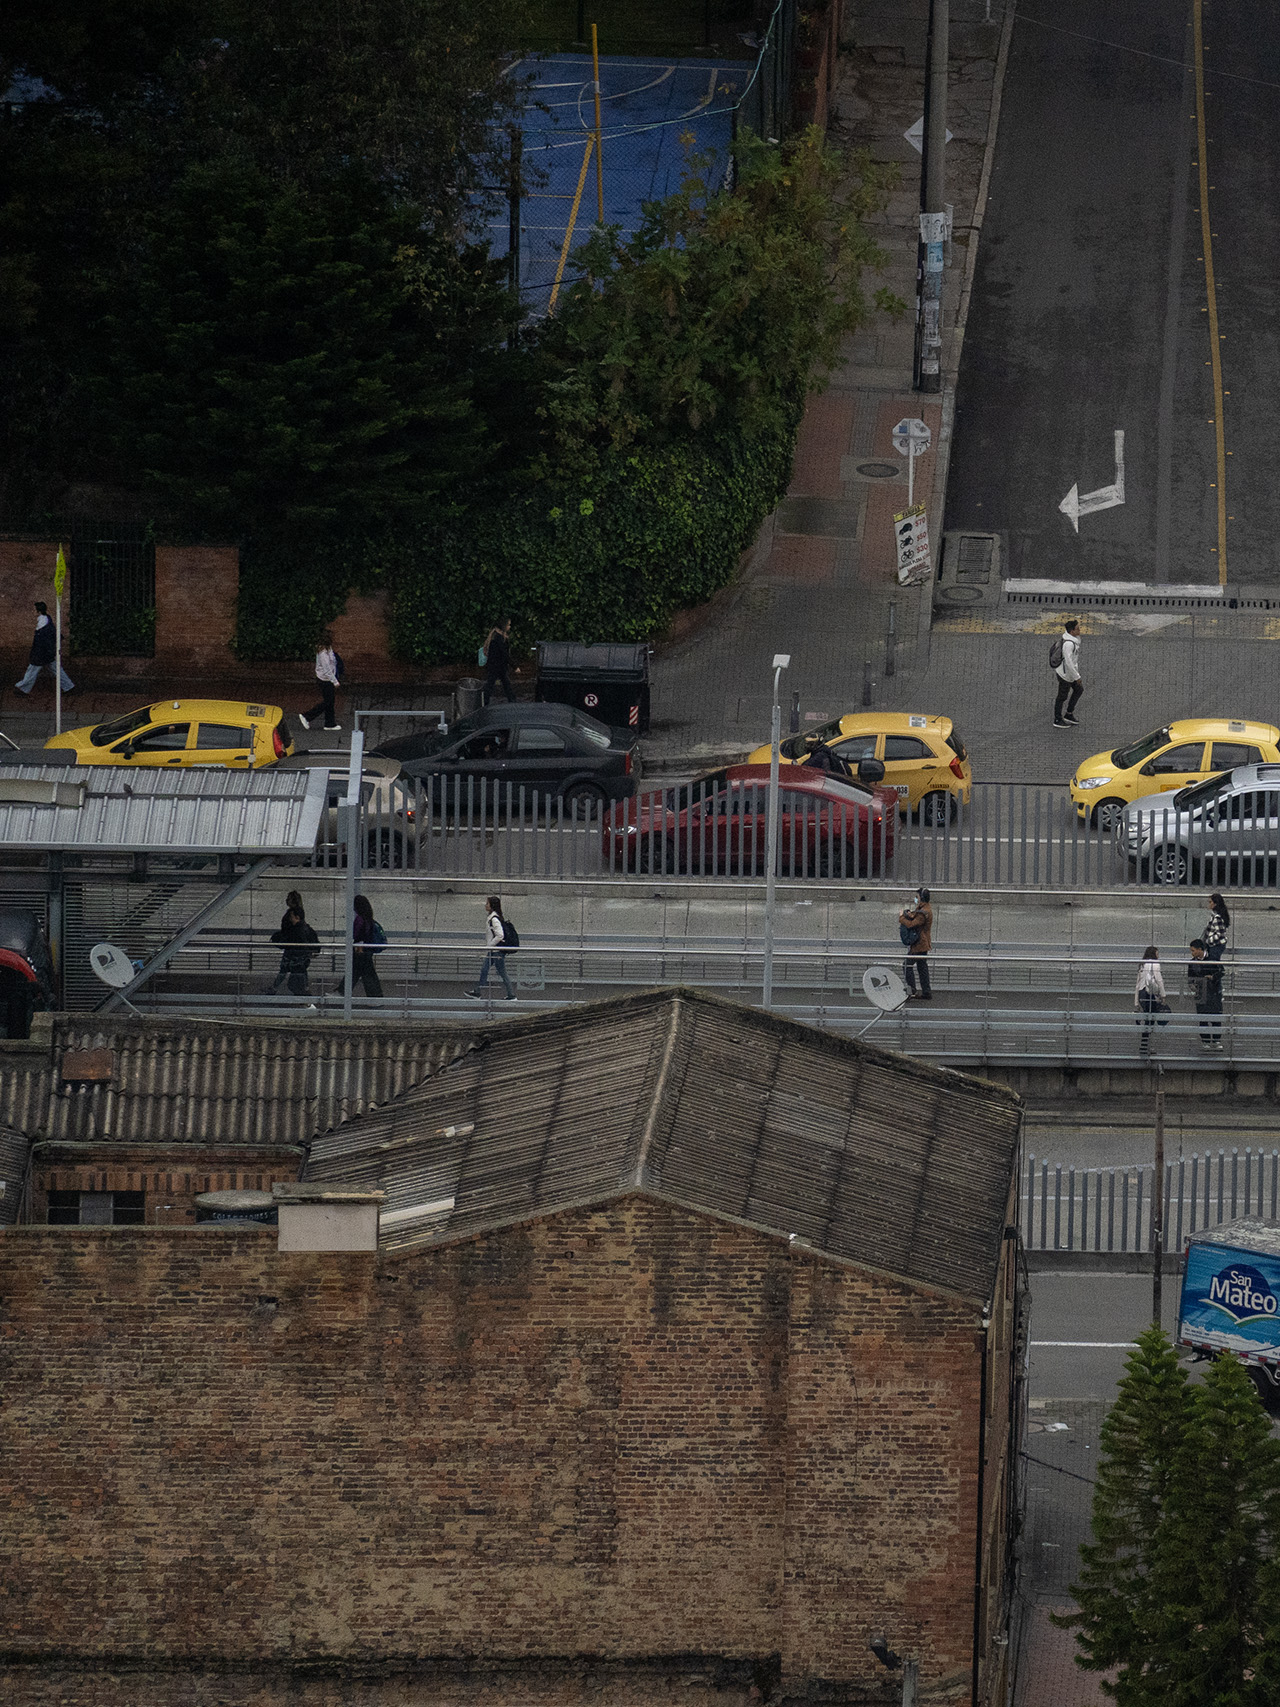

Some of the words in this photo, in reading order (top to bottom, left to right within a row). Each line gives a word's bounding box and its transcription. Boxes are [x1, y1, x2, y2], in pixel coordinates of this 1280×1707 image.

[915, 517, 926, 527] $70
[916, 532, 927, 542] $50
[916, 544, 929, 554] $30
[1230, 1270, 1252, 1288] San
[1209, 1276, 1277, 1314] Mateo
